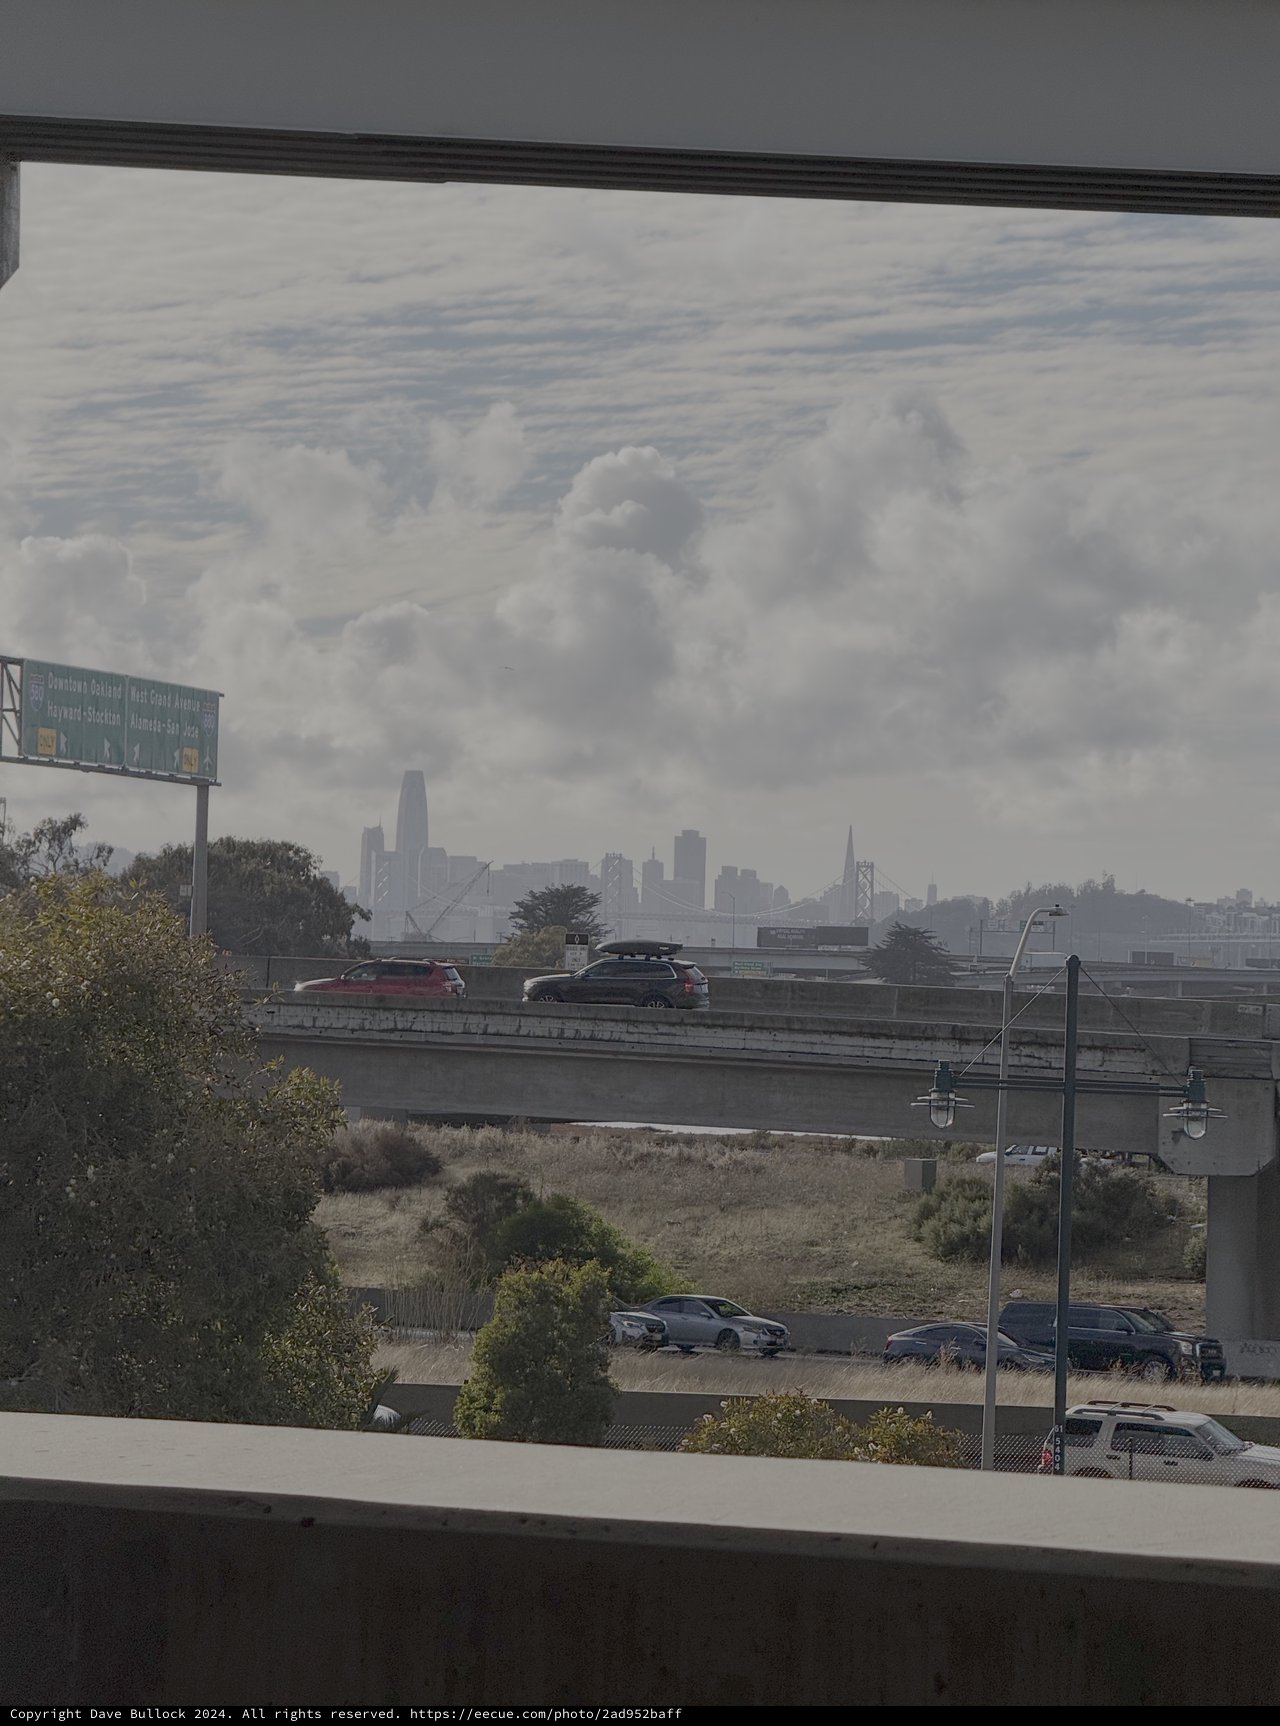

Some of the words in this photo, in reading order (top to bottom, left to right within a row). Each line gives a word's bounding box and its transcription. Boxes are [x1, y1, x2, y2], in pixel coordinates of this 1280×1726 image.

[30, 684, 44, 701] 580
[47, 672, 88, 694] Downtown
[91, 679, 122, 699] Oakland
[130, 685, 147, 703] West
[150, 690, 171, 708] Grand
[174, 693, 200, 712] Avenue
[47, 700, 121, 726] Hayward-Stockton
[130, 712, 179, 736] Alameda-San
[183, 721, 199, 738] Jose
